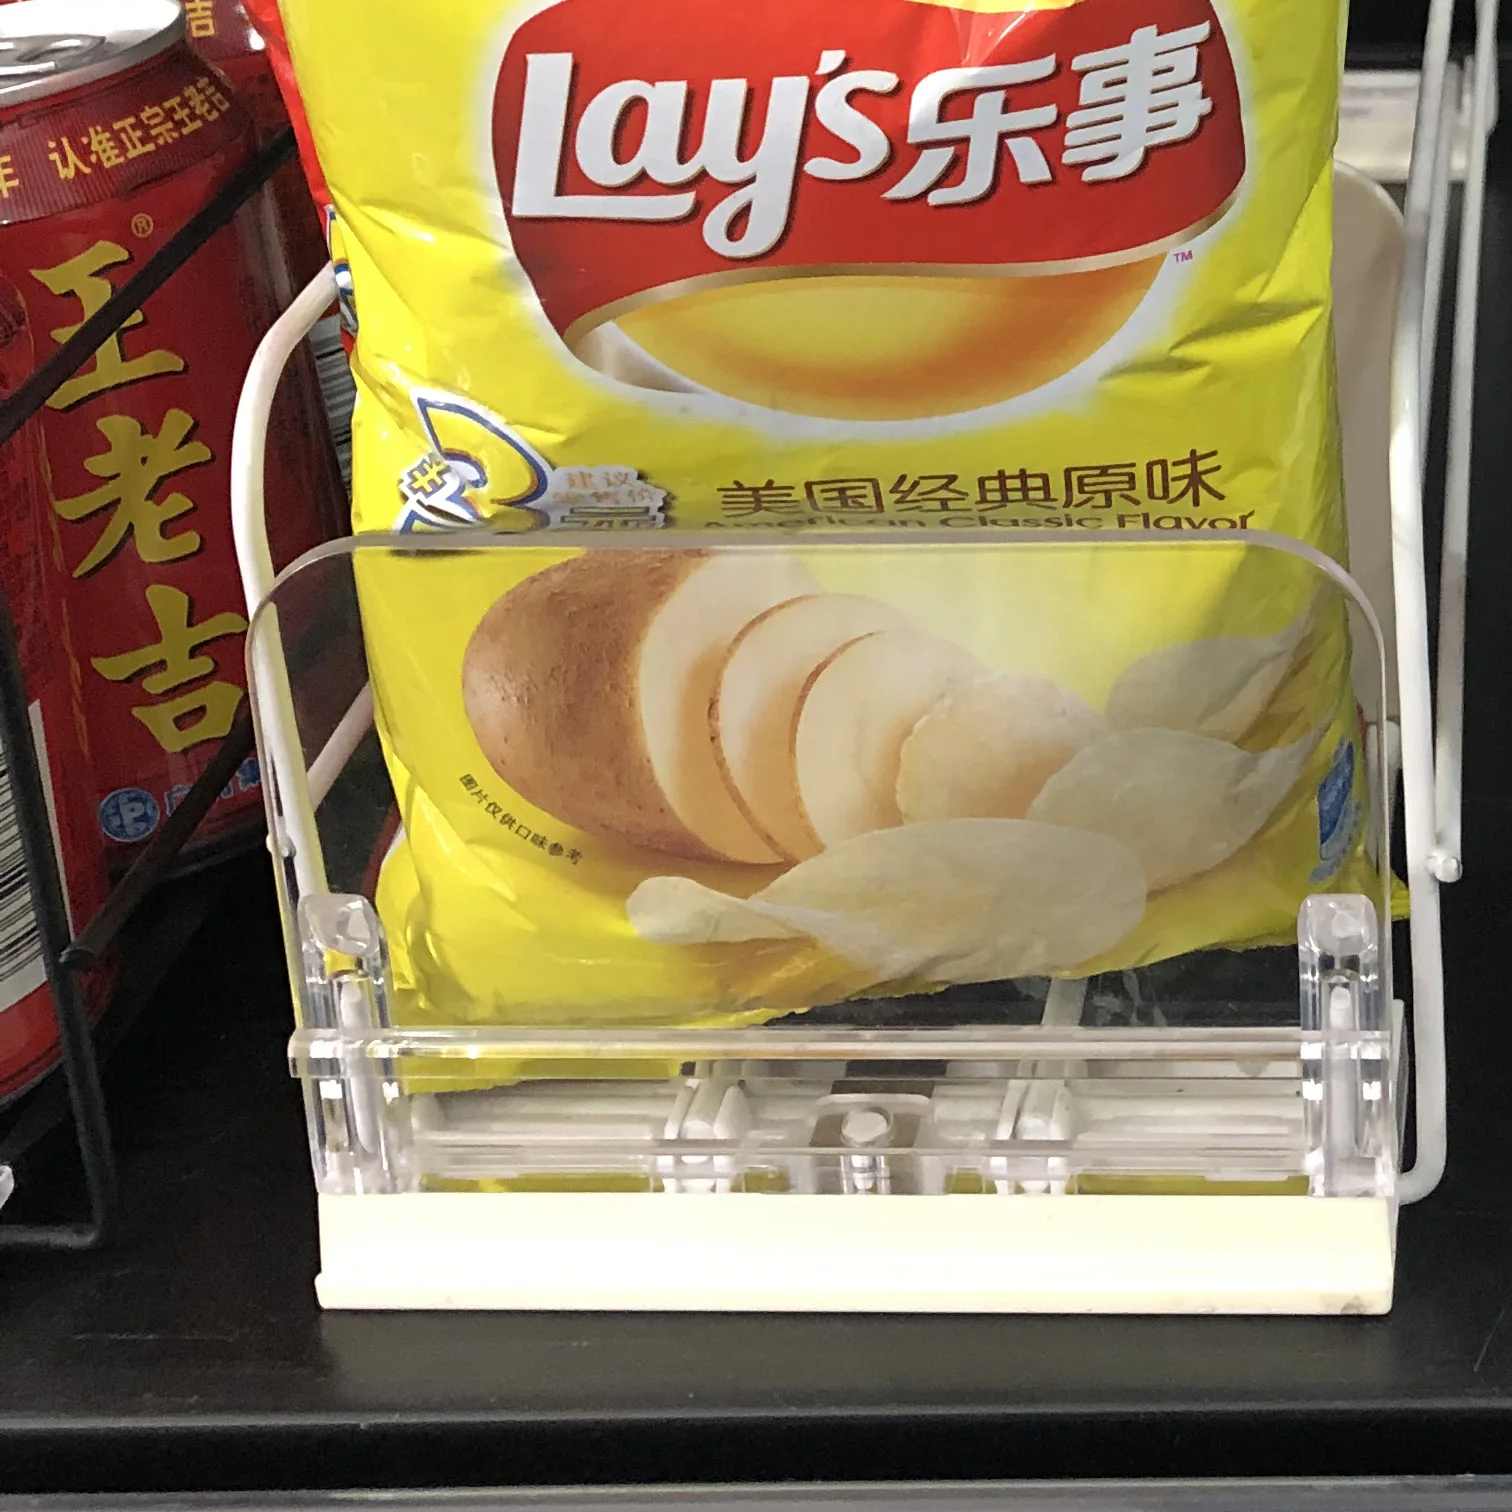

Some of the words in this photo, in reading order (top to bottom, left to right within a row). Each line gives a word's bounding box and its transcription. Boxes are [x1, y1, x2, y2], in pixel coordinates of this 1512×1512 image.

[48, 76, 231, 180] 认准正宗王老吉
[28, 239, 249, 754] 王老吉
[716, 449, 1227, 519] 美国经典原味
[940, 513, 1103, 529] Classic
[1116, 510, 1256, 531] Flavor
[459, 773, 583, 866] 图片仅供口味参考
